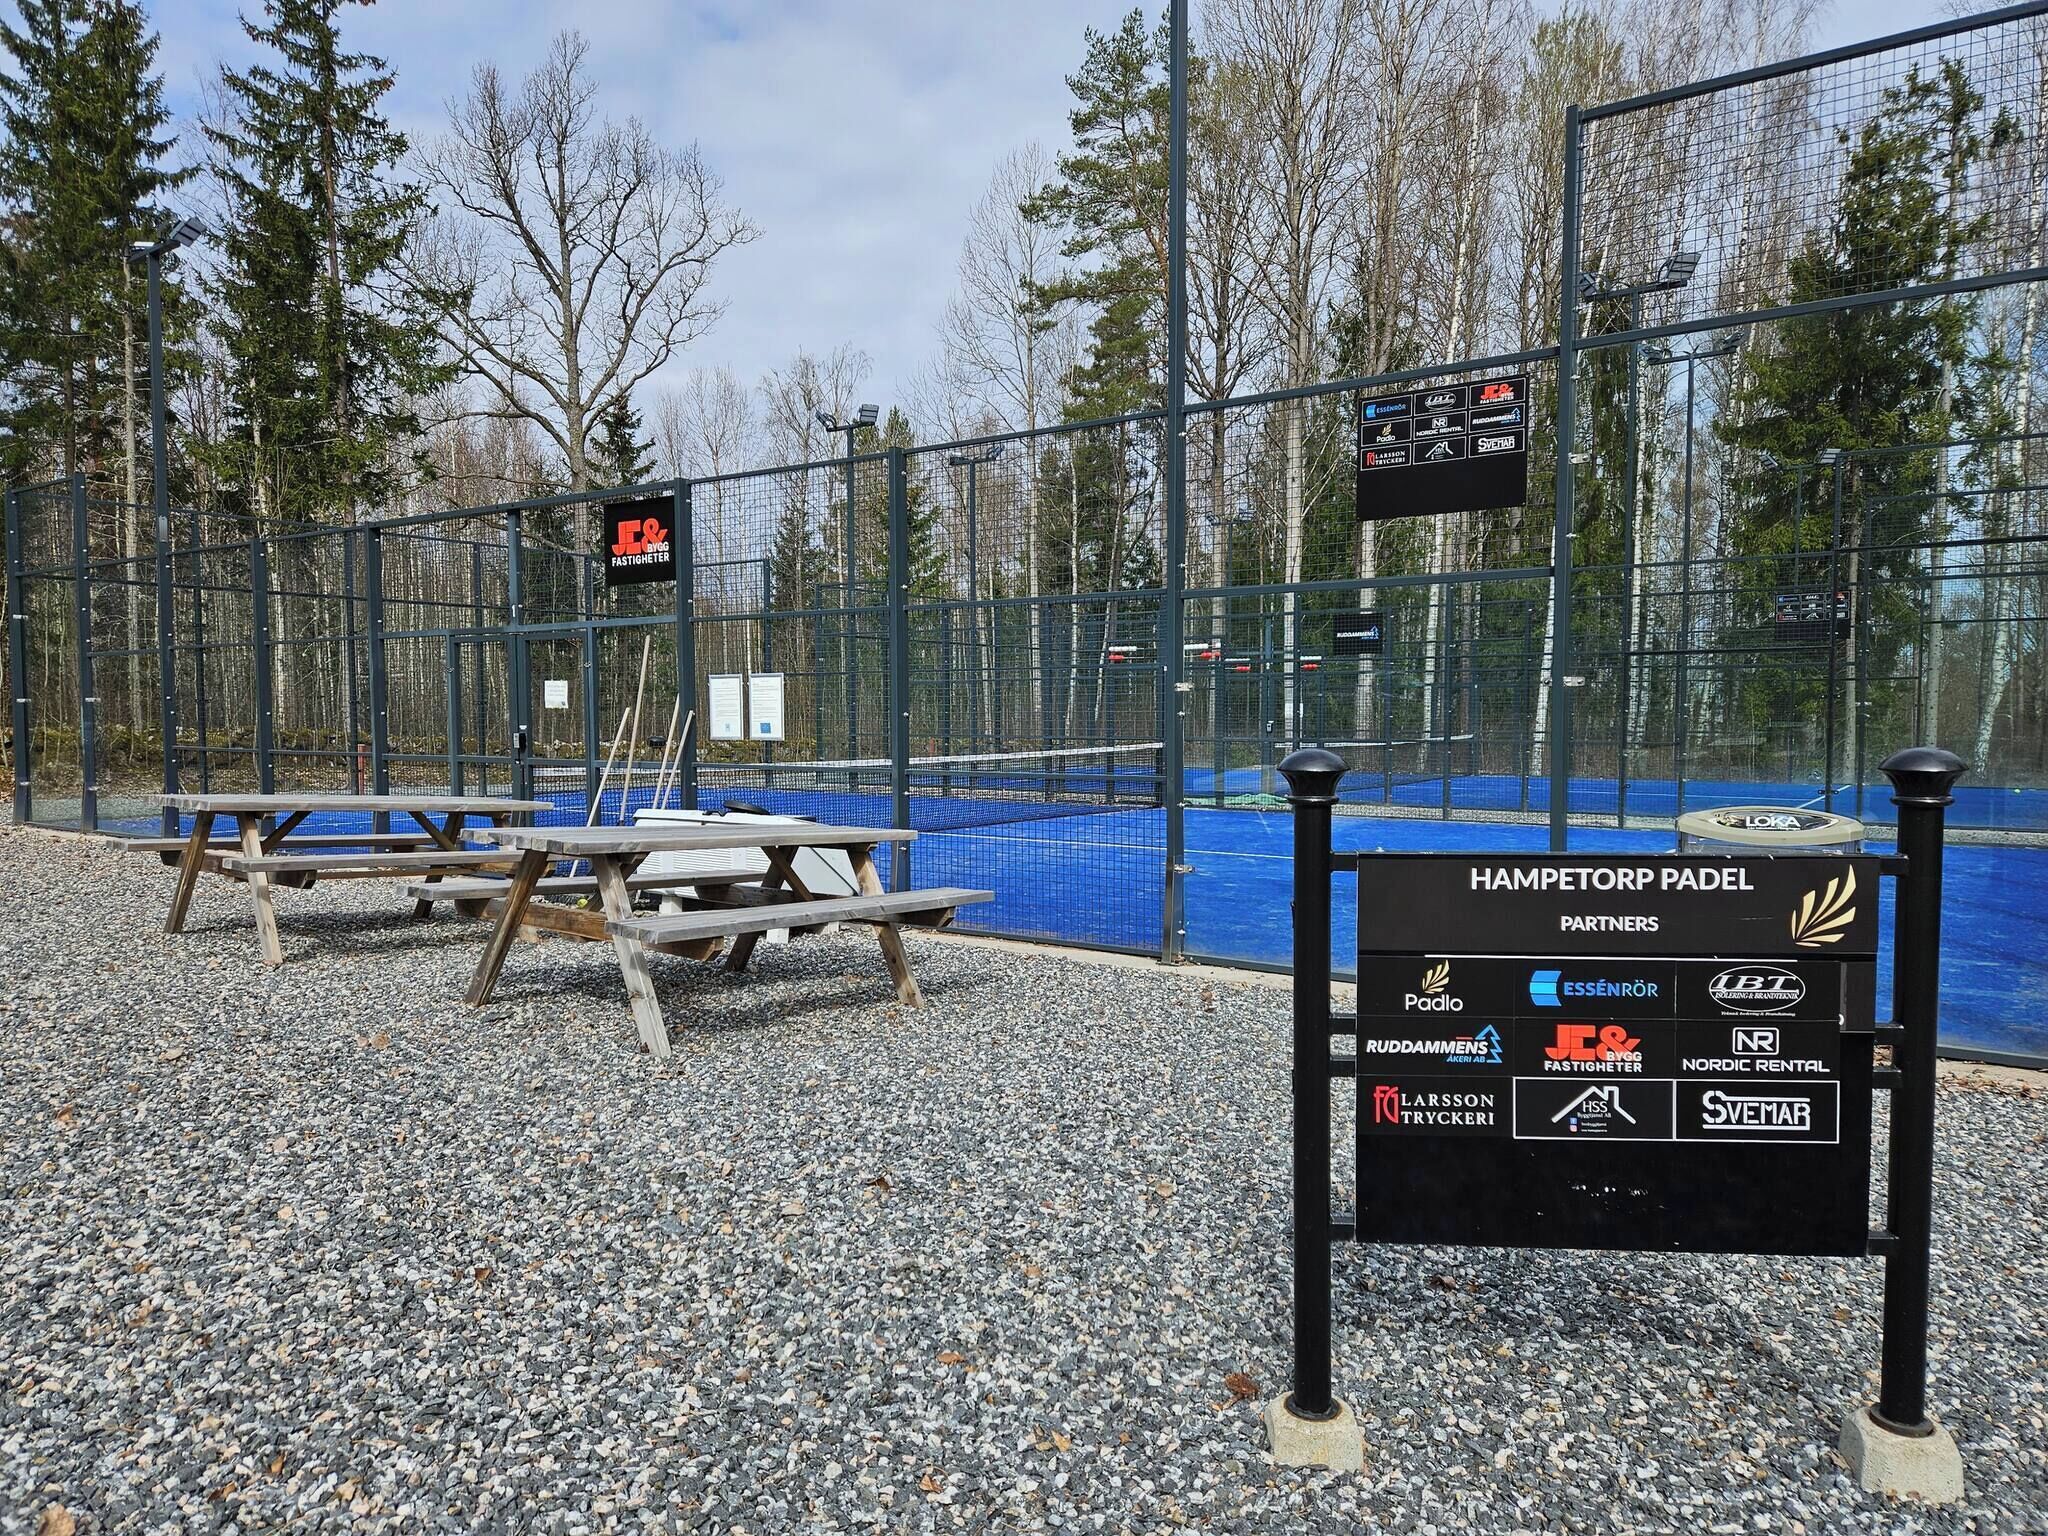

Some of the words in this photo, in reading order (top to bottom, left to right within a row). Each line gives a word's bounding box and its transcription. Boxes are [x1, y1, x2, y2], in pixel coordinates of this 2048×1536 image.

[1433, 419, 1446, 427] NR
[1375, 450, 1406, 460] LARSSON
[646, 541, 669, 553] BYGG
[611, 552, 670, 567] FASTIGHETER
[1745, 814, 1801, 828] LOKA
[1471, 867, 1655, 891] HAMPETORP
[1660, 867, 1754, 891] PADEL
[1560, 915, 1660, 932] PARTNERS
[1563, 979, 1659, 997] ESSÉNRÖR
[1711, 974, 1797, 991] IBT
[1405, 993, 1464, 1012] Padlo
[1366, 1040, 1489, 1055] RUDDAMMENS
[1737, 1031, 1774, 1051] NR
[1472, 1055, 1487, 1063] AB
[1606, 1051, 1643, 1062] BYGG
[1544, 1061, 1643, 1073] FASTIGHETER
[1682, 1058, 1751, 1072] NORDIC
[1755, 1059, 1831, 1073] RENTAL
[1401, 1093, 1495, 1108] LARSSON
[1582, 1100, 1608, 1113] HSS
[1702, 1090, 1811, 1126] SVEMAR
[1401, 1111, 1495, 1126] TRYCKERI
